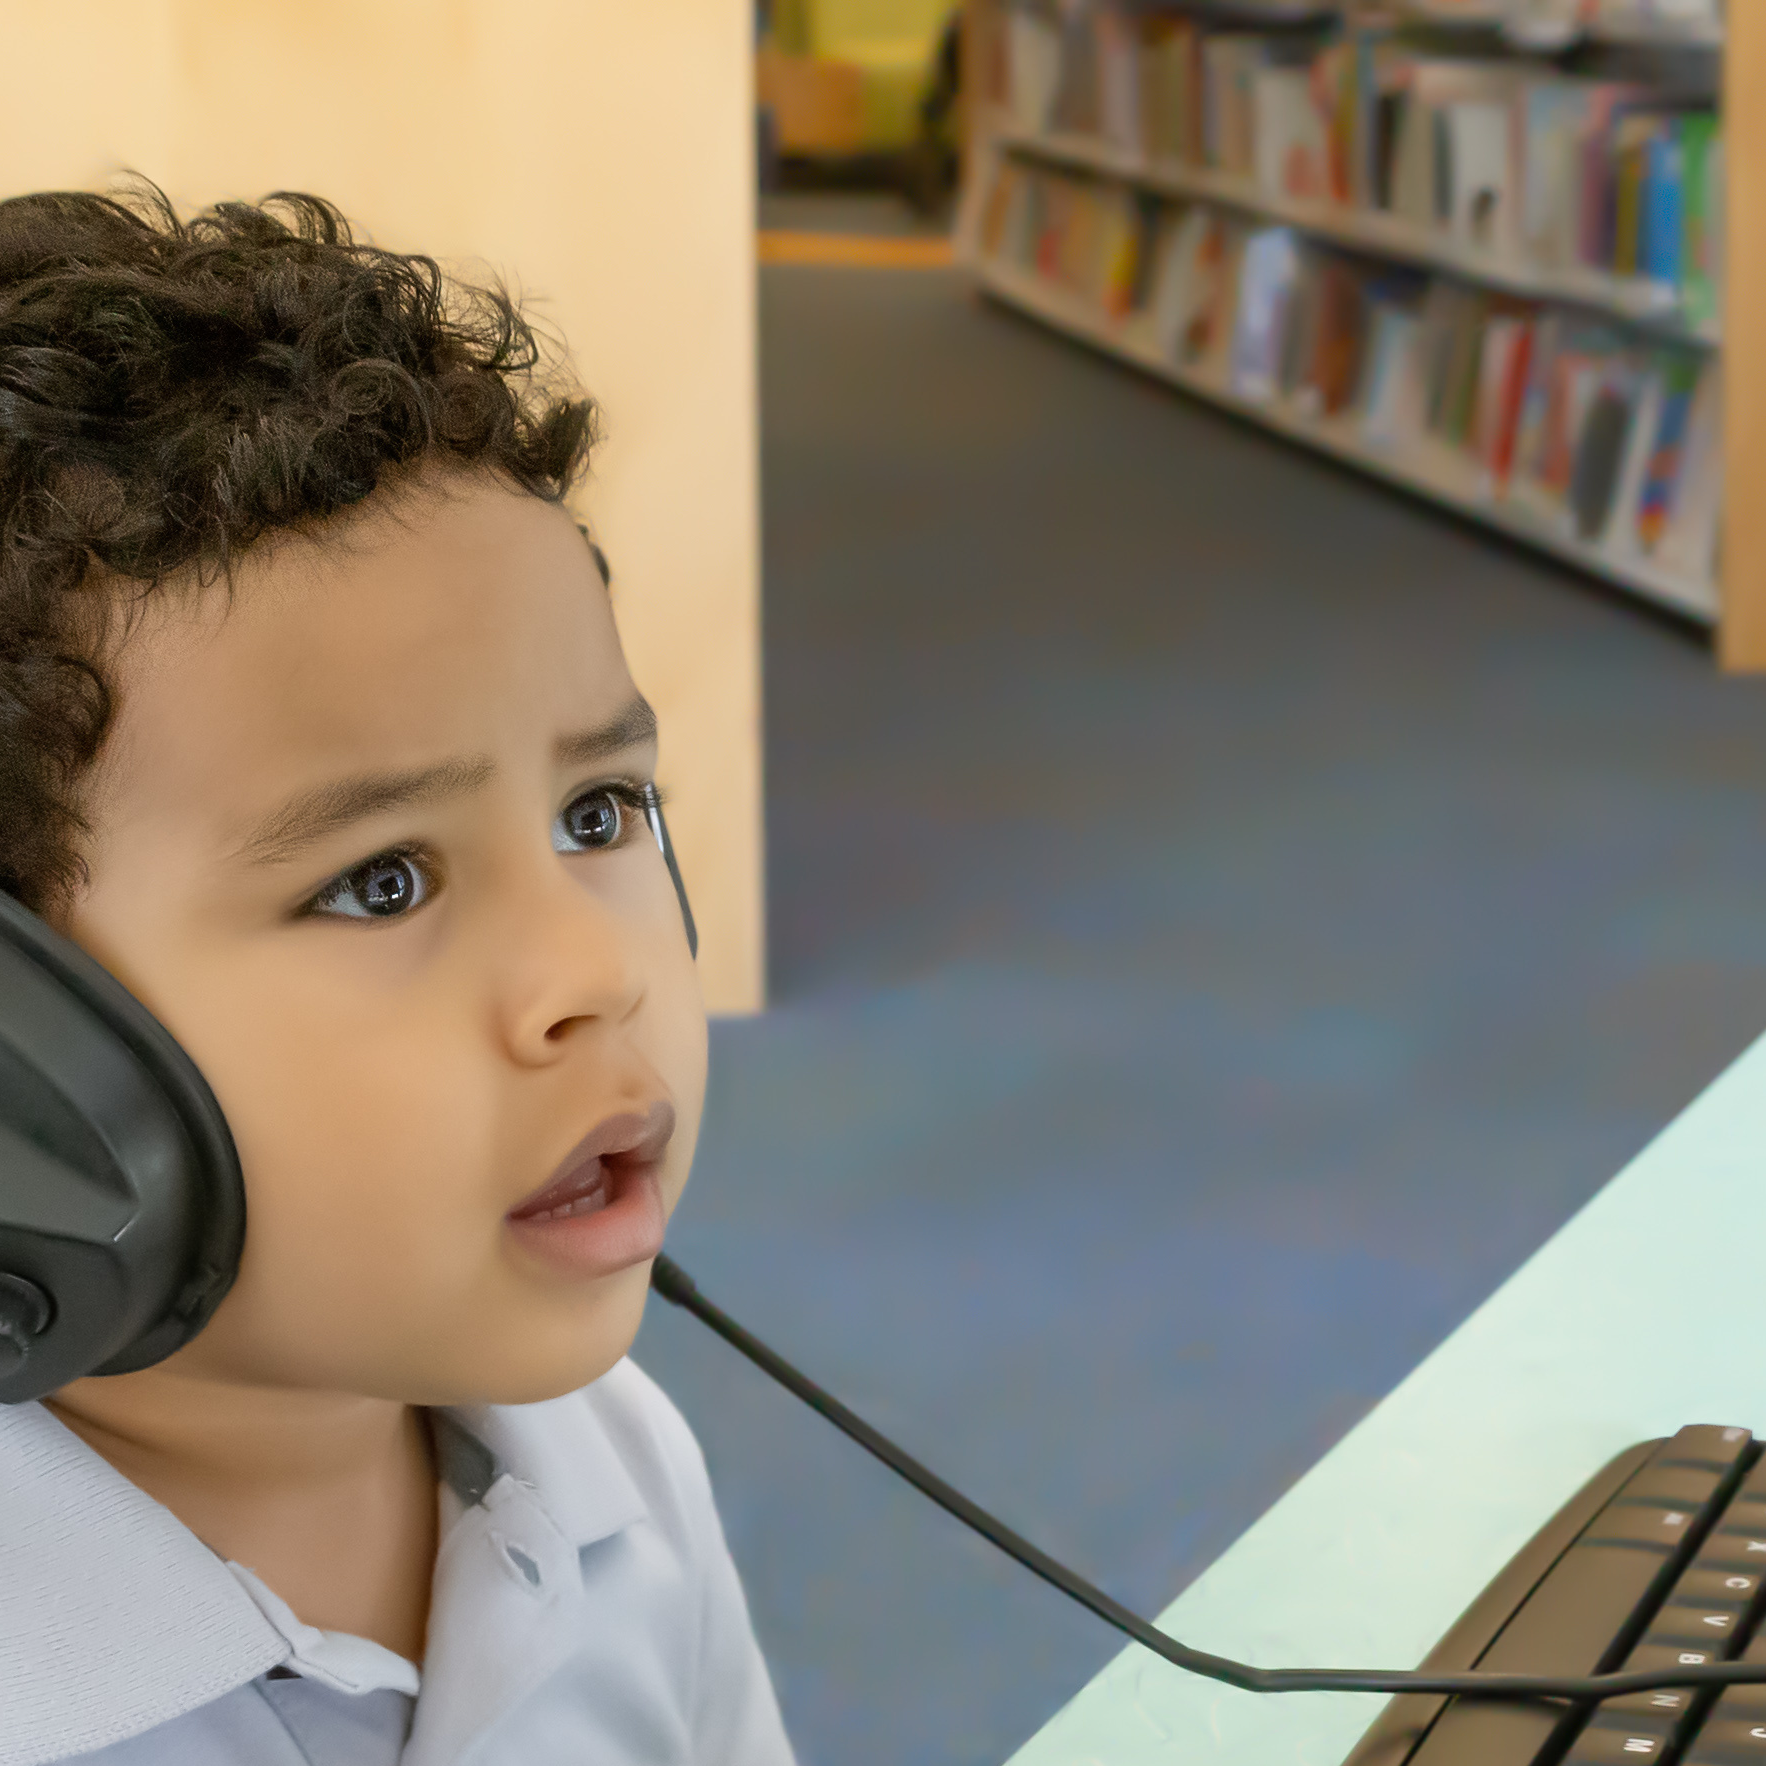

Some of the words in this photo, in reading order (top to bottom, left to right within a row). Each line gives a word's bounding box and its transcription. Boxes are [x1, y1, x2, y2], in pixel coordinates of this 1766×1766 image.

[1723, 1575, 1752, 1590] C
[1701, 1614, 1730, 1628] V
[1677, 1652, 1707, 1666] B
[1650, 1693, 1681, 1708] N
[1622, 1737, 1656, 1754] M
